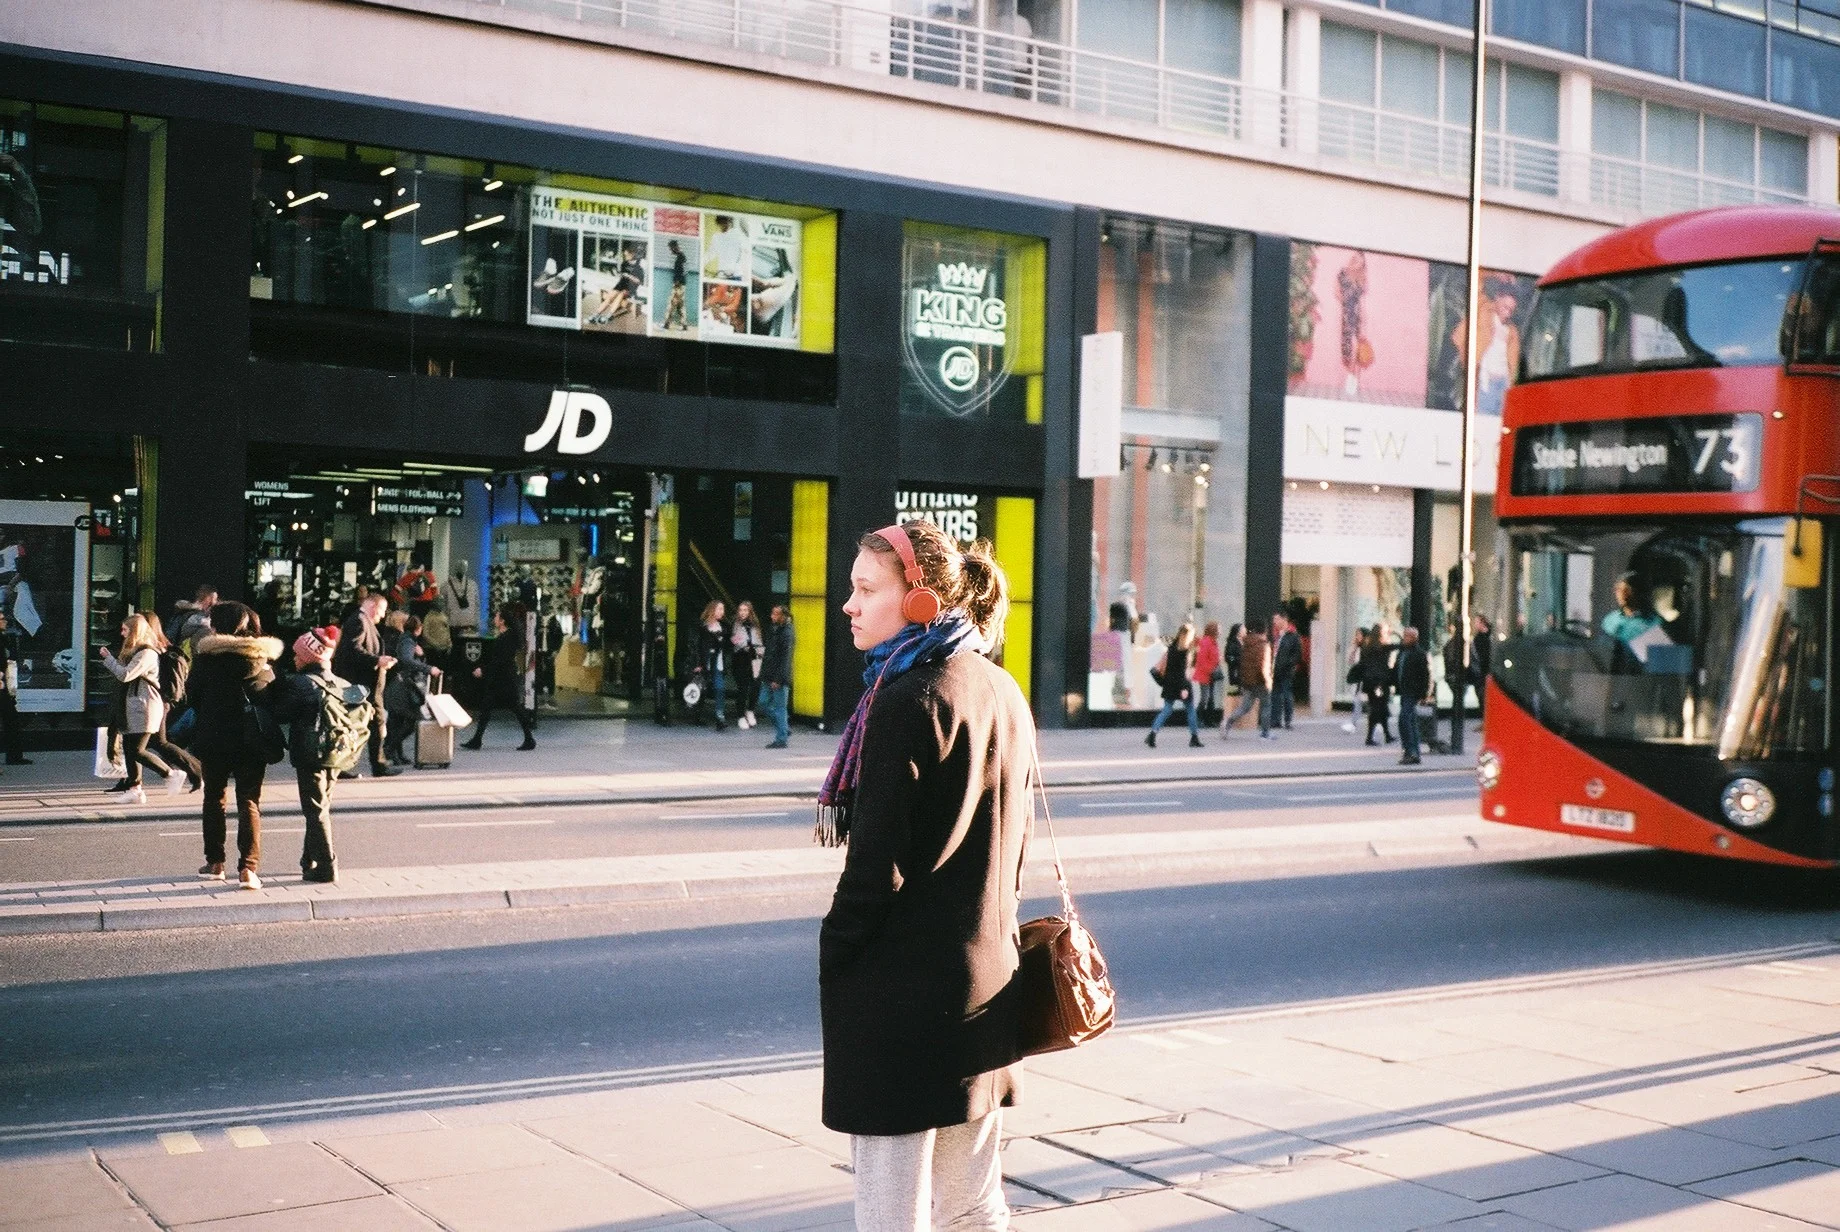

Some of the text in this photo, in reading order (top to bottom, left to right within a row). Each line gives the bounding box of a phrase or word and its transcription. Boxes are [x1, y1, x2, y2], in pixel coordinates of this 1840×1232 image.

[532, 207, 554, 219] NOT
[560, 211, 584, 223] JUST
[589, 214, 611, 228] ONE
[616, 218, 648, 232] THING
[533, 194, 648, 220] THE AUTHENTIC
[762, 222, 793, 238] VANS
[915, 288, 1007, 330] KING
[945, 355, 974, 380] JD
[524, 389, 612, 455] JD
[1304, 423, 1408, 462] NEW
[1532, 428, 1746, 481] Stoke Newington 73
[254, 481, 289, 491] WOMENS
[253, 497, 271, 507] LIFT
